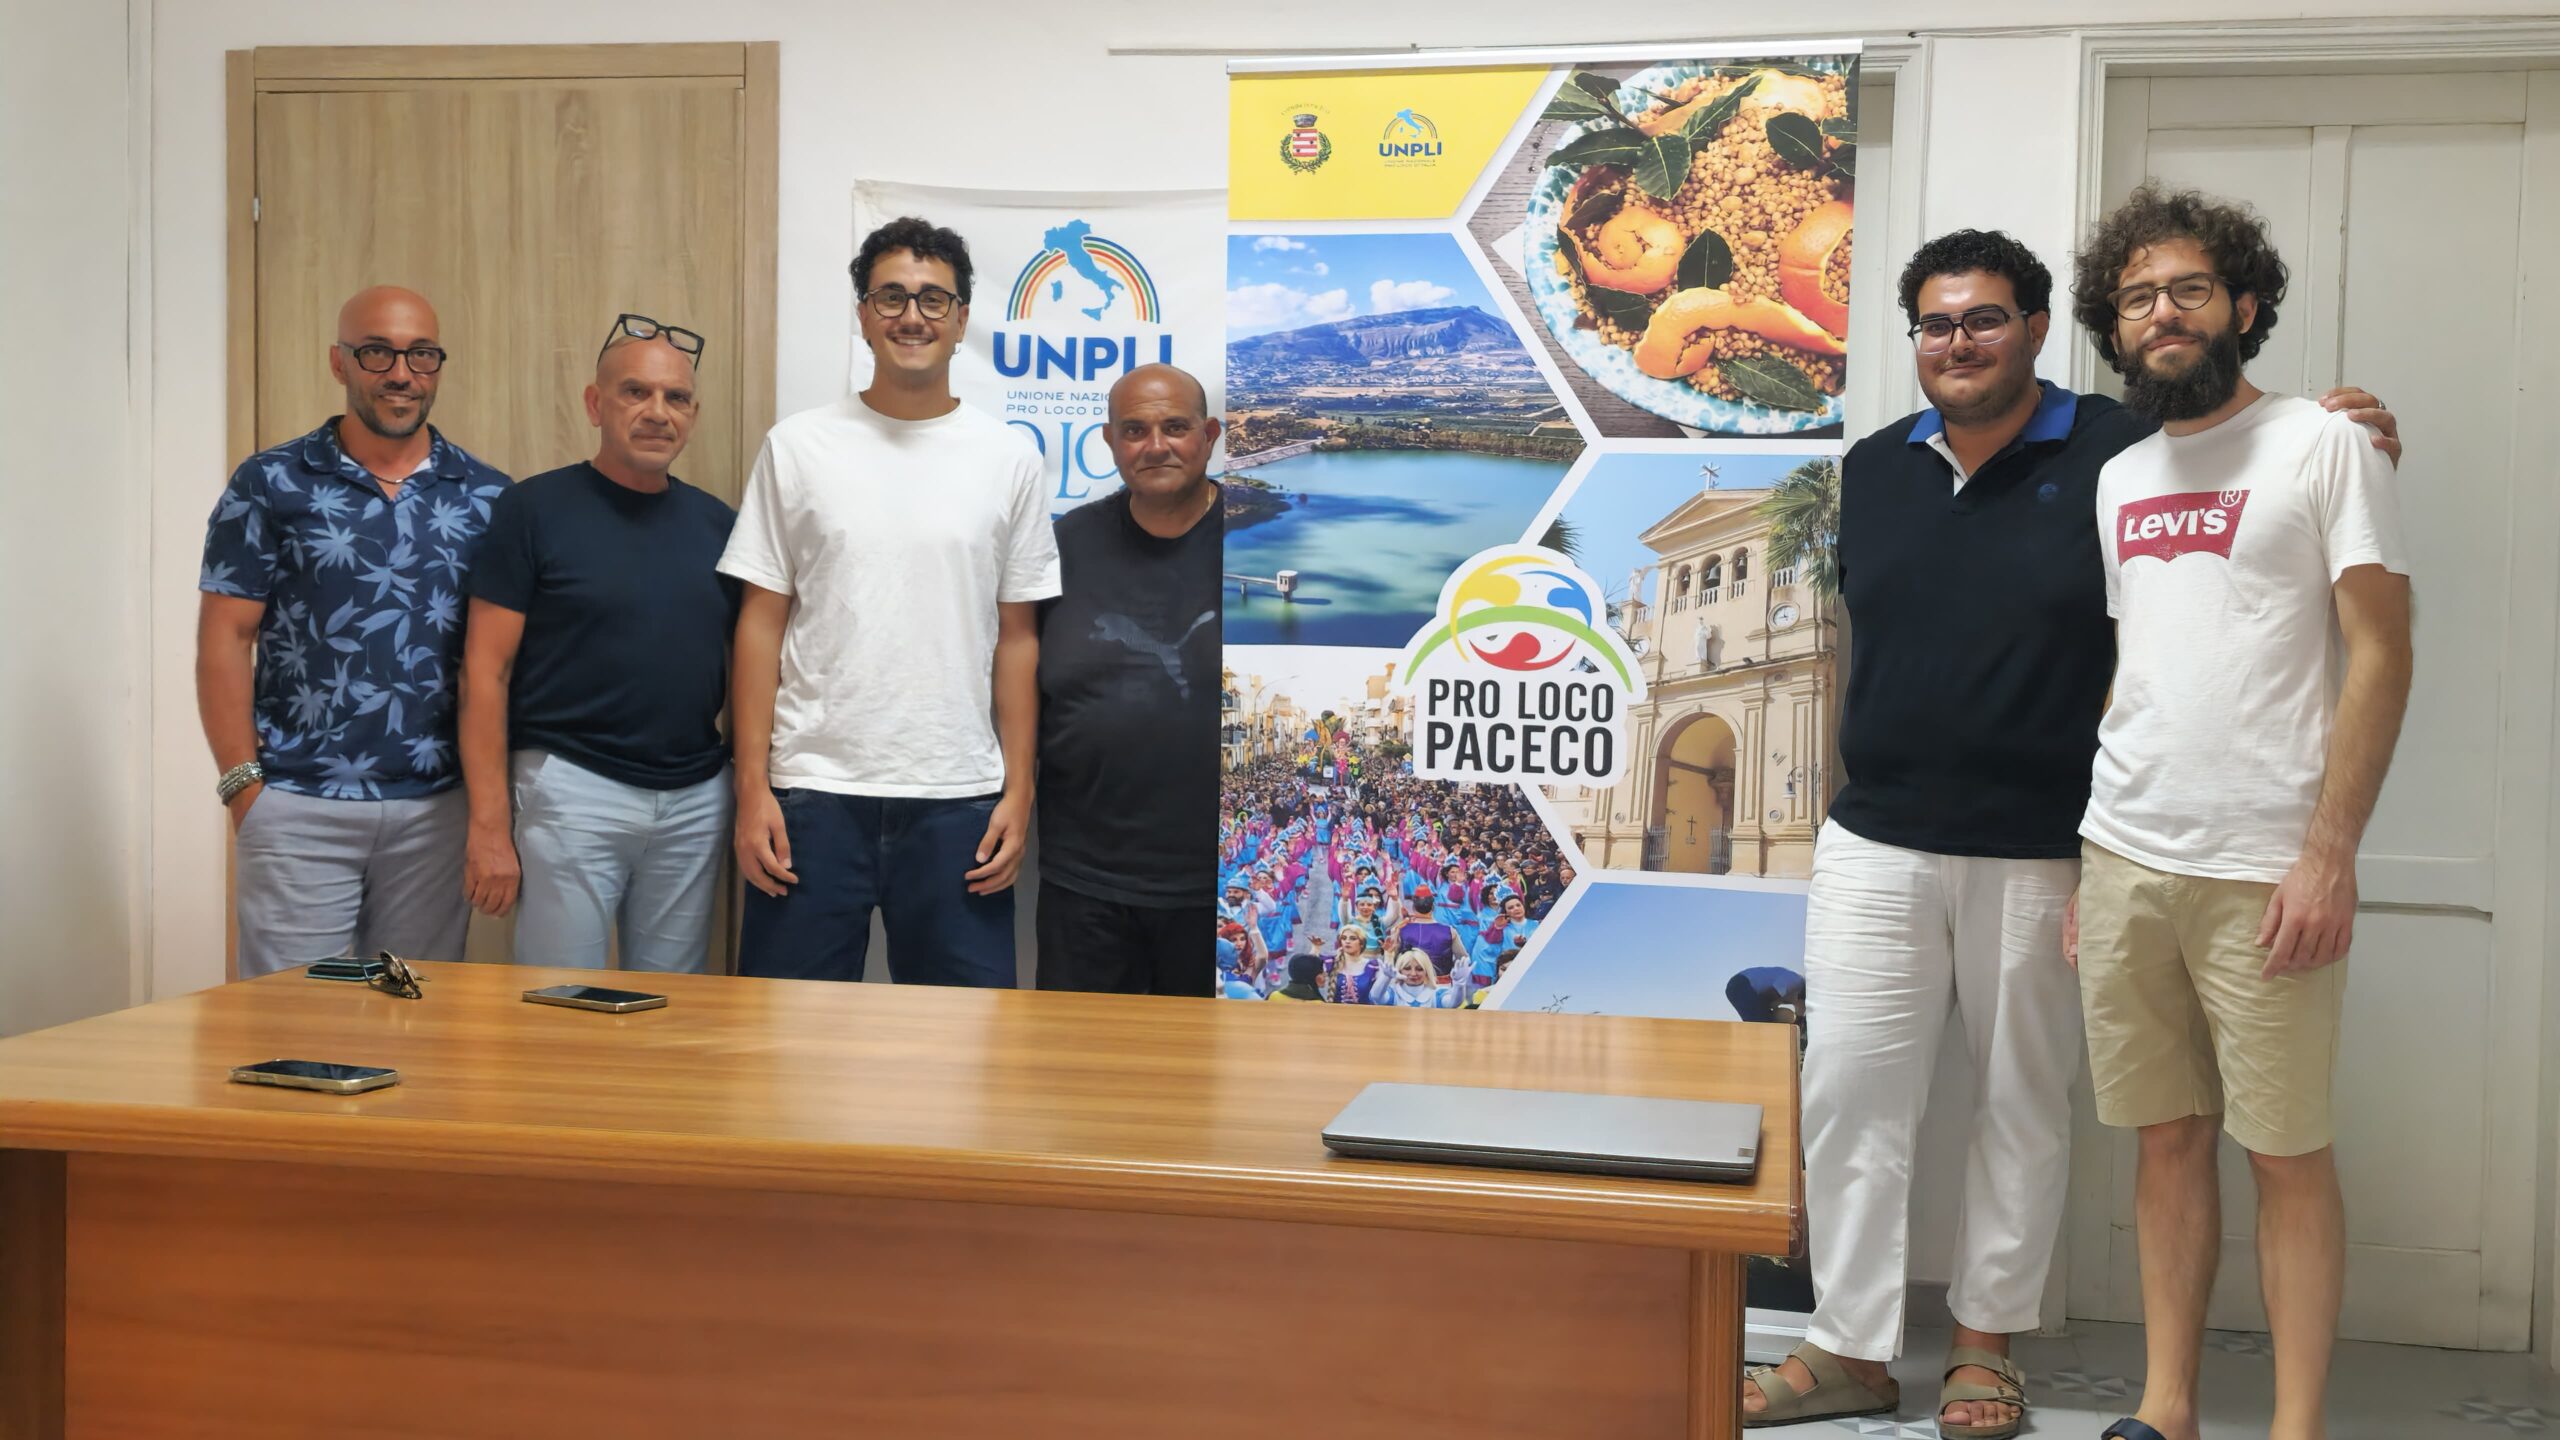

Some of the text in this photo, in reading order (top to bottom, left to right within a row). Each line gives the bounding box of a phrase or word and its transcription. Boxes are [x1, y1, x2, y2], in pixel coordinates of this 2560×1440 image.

[1379, 141, 1442, 157] UNPLI
[1006, 390, 1065, 401] UNIONE
[1006, 404, 1039, 415] PRO
[1044, 405, 1087, 416] LOCO
[1428, 679, 1614, 723] PRO LOCO
[1426, 721, 1614, 778] PACECO
